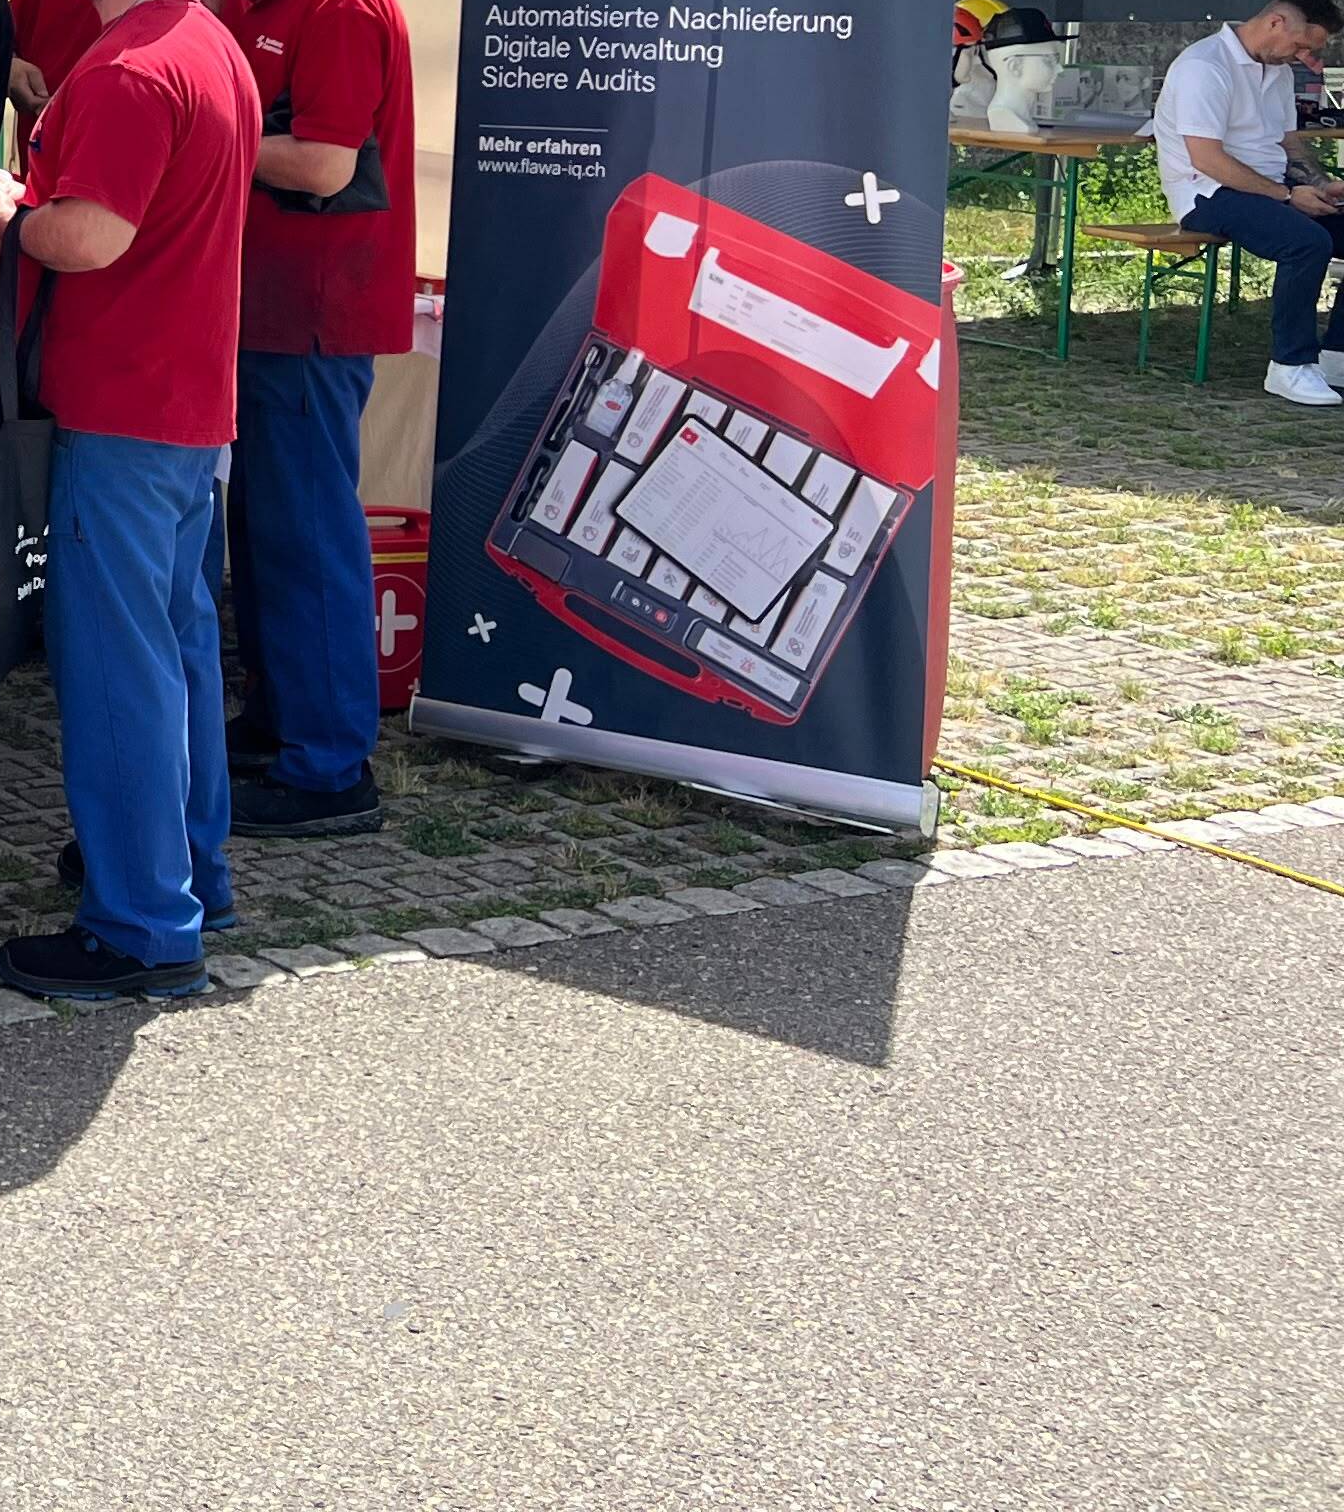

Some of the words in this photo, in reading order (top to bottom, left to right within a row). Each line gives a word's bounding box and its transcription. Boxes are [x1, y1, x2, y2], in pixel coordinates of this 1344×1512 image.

[485, 4, 660, 29] Automatisierte
[669, 6, 853, 40] Nachlieferung
[484, 35, 571, 63] Digitale
[579, 37, 724, 68] Verwaltung
[482, 65, 568, 90] Sichere
[576, 68, 656, 93] Audits
[478, 136, 523, 155] Mehr
[526, 137, 602, 157] erfahren
[477, 158, 606, 180] www.flawa-iq.ch
